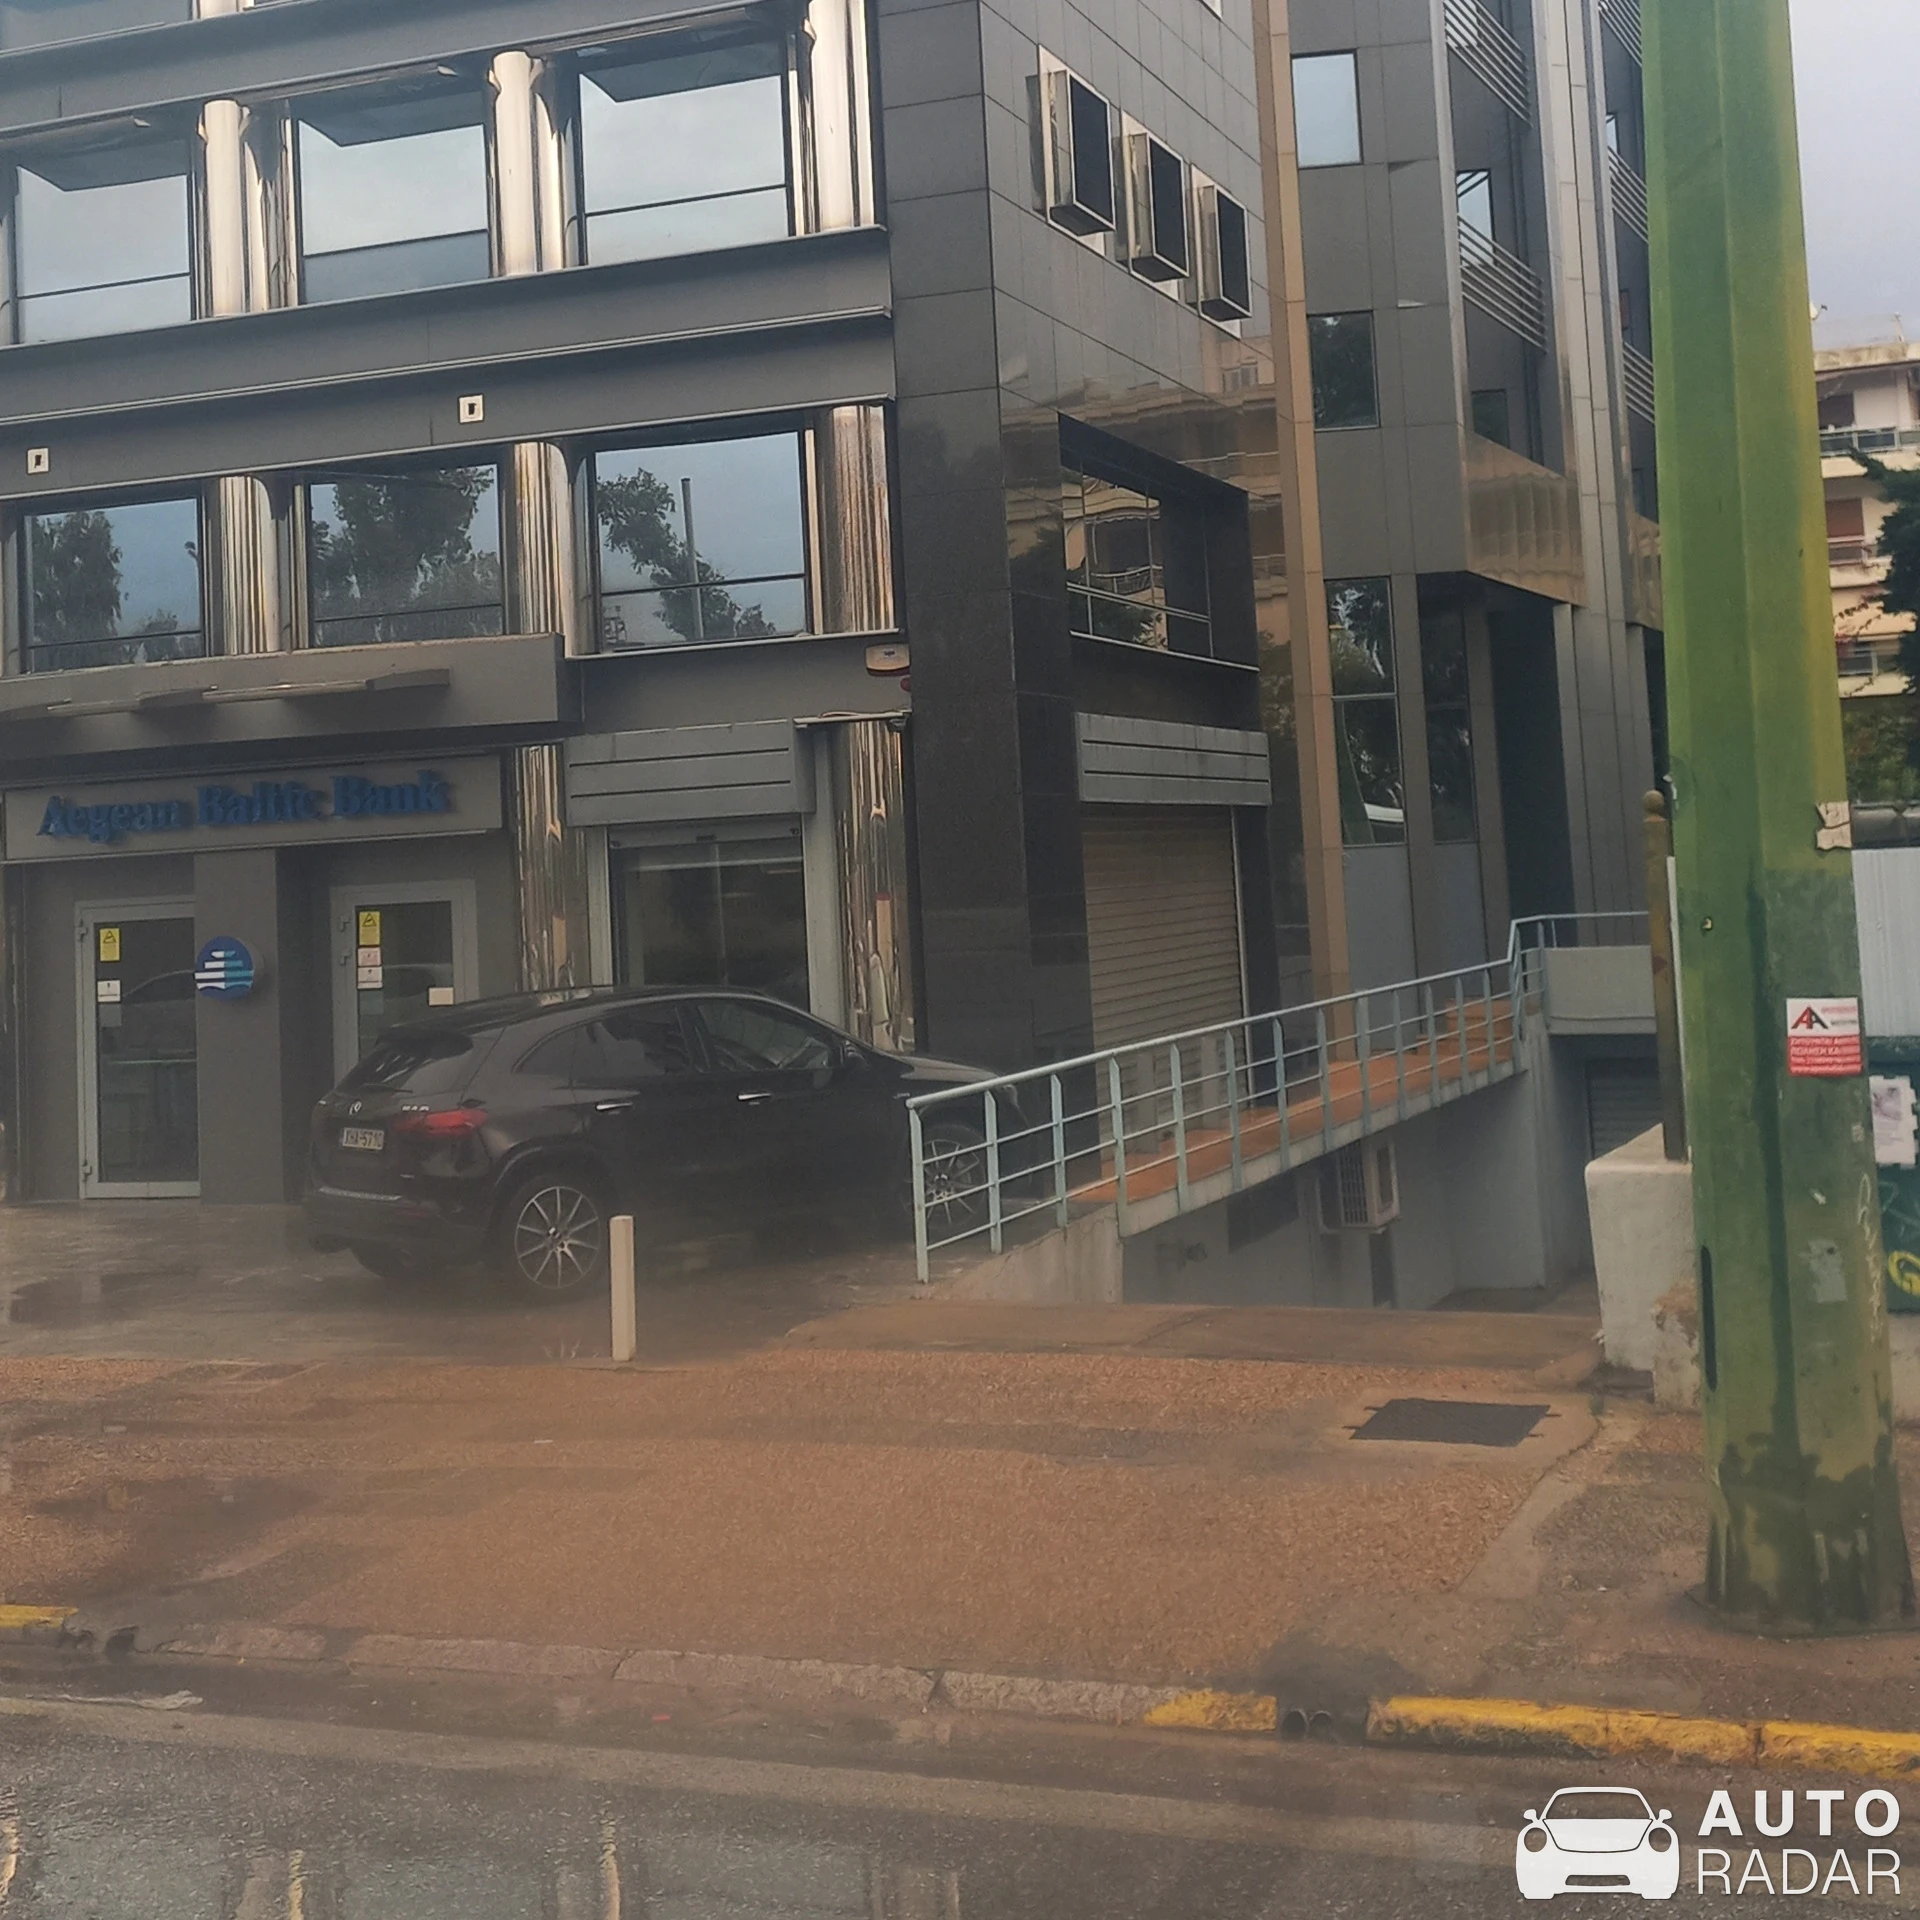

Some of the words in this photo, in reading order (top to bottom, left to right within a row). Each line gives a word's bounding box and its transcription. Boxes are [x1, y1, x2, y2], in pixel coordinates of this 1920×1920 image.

[37, 794, 181, 843] Aegean
[198, 780, 315, 826] Baltic
[331, 769, 448, 820] Bank
